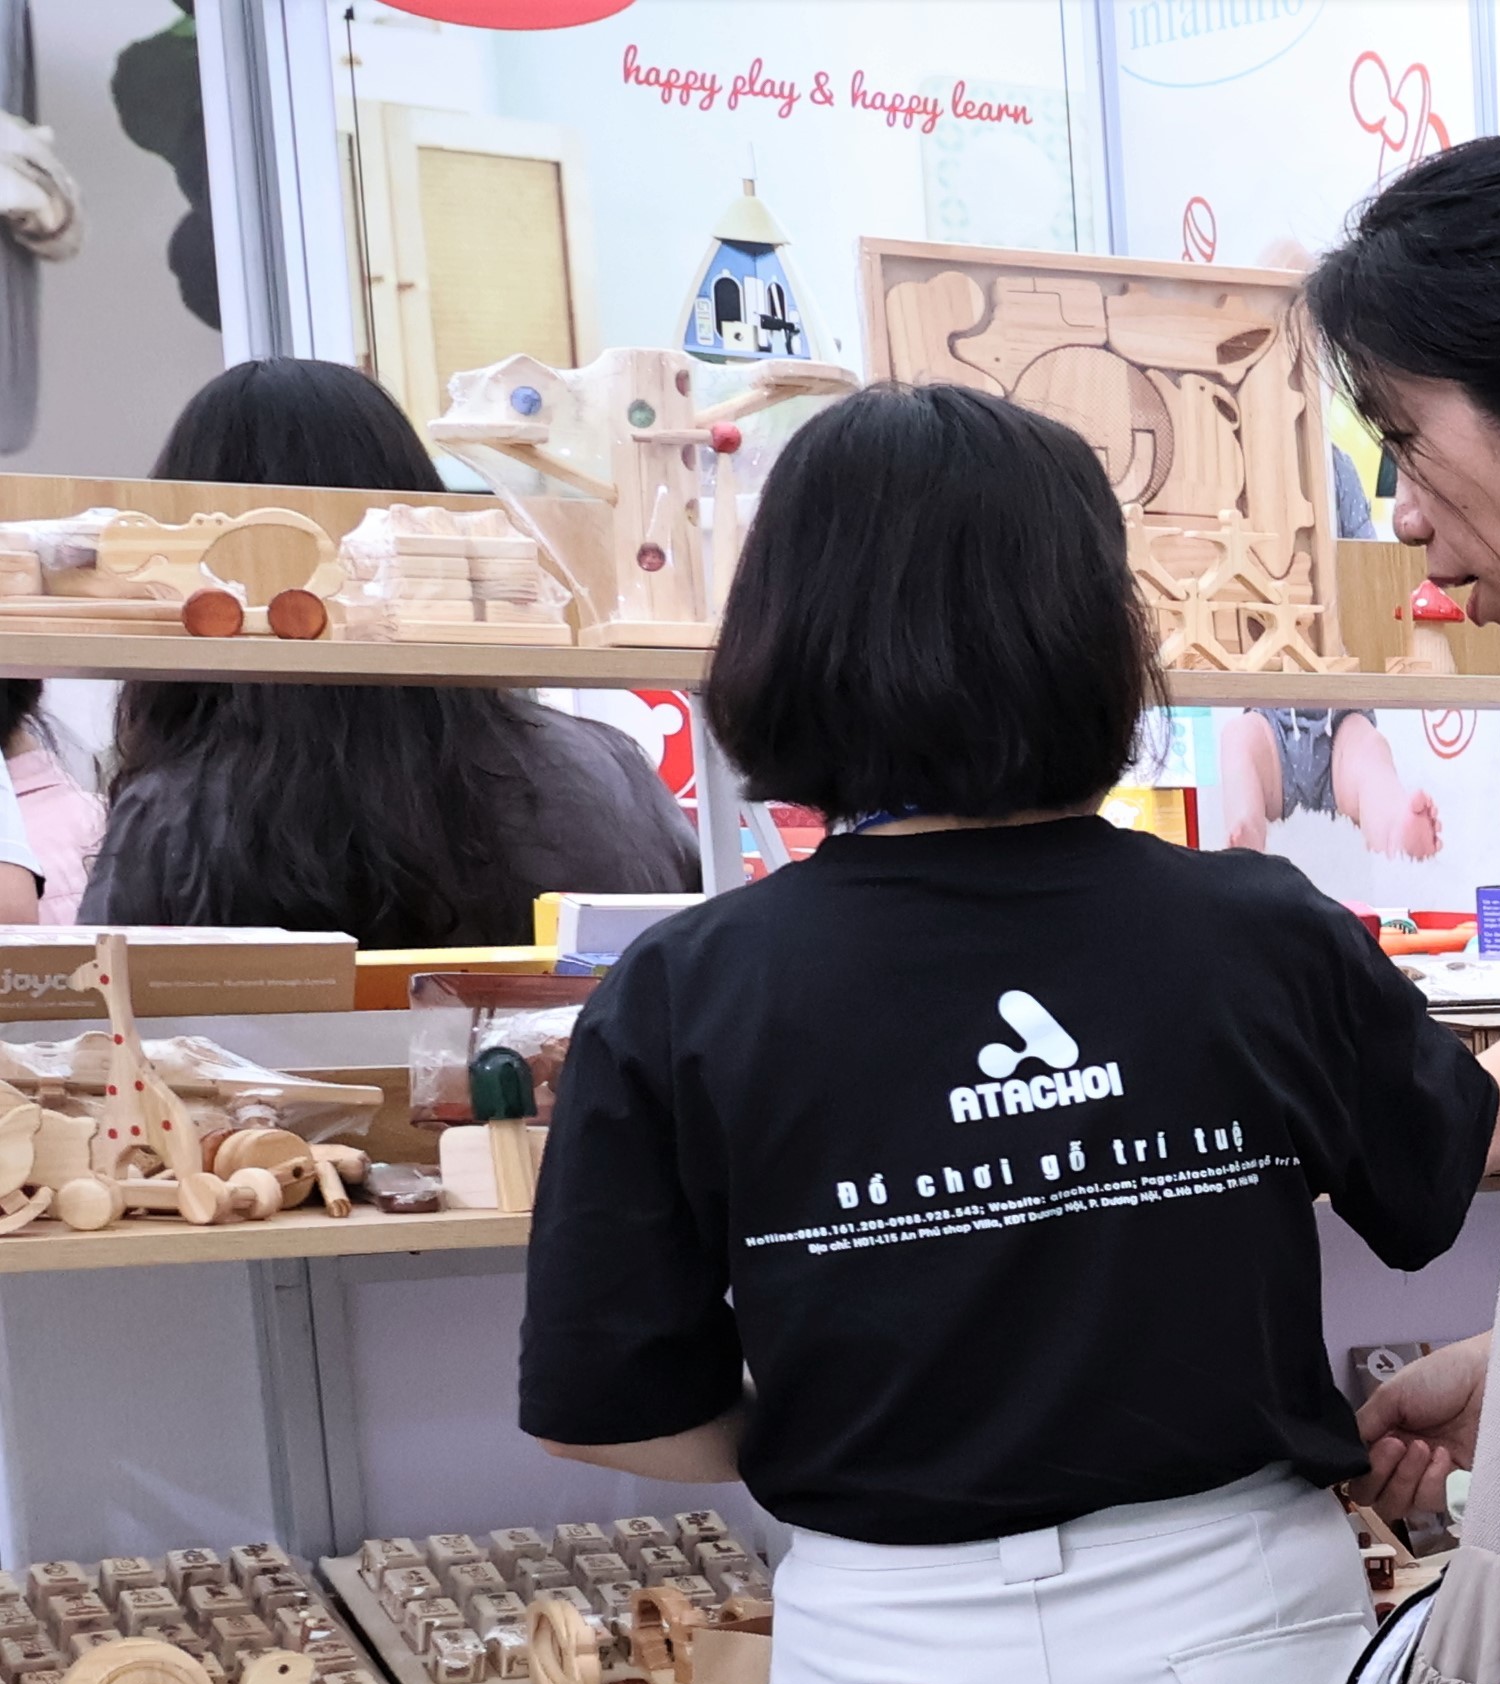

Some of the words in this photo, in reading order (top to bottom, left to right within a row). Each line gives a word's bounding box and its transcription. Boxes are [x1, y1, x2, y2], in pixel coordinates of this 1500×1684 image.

[622, 44, 722, 111] happy
[727, 57, 801, 119] play
[809, 71, 834, 107] &
[850, 69, 944, 135] happy
[950, 80, 1033, 126] learn
[949, 1061, 1125, 1124] ATACHOI
[836, 1172, 888, 1210] Đồ
[915, 1157, 1014, 1198] chơi
[1040, 1139, 1087, 1181] gỗ
[1112, 1130, 1168, 1166] trí
[1193, 1120, 1244, 1154] tuệ
